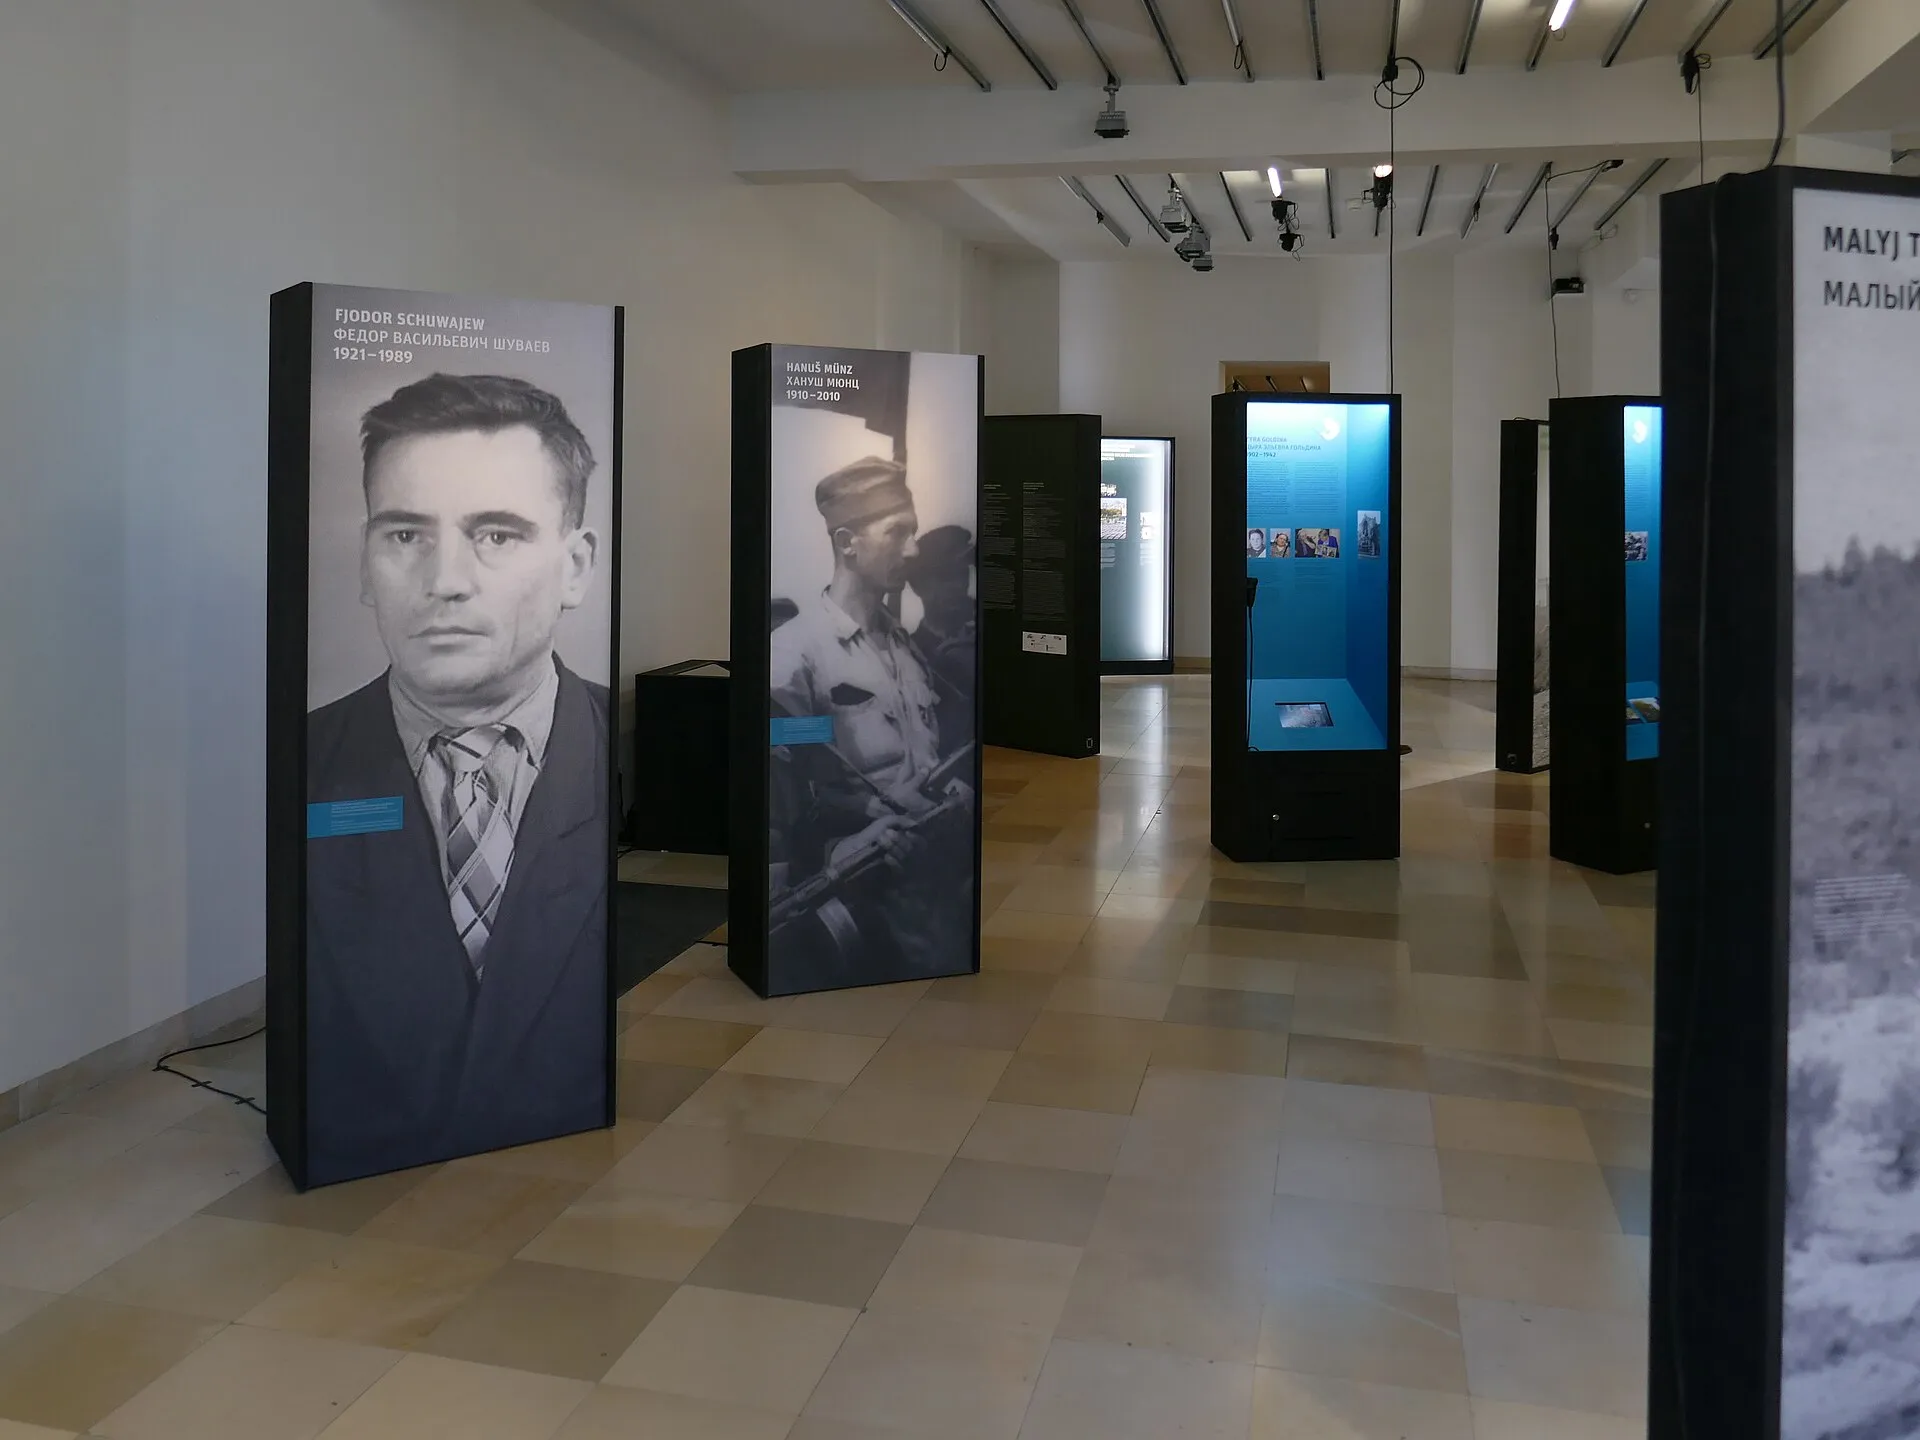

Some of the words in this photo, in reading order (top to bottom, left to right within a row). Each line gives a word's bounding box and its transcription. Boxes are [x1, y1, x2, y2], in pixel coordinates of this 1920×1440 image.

[1824, 226, 1899, 261] MALYJ
[1824, 279, 1920, 311] МАЛЫЙ
[335, 308, 393, 325] FJODOR
[397, 312, 486, 331] SCHUWAJEW
[333, 327, 389, 344] ФЕДОР
[393, 331, 489, 349] ВАСИЛЬЕВИЧ
[493, 337, 550, 353] ШУВАЕВ
[333, 346, 413, 364] 1921–1989
[786, 361, 821, 373] HANUŠ
[824, 362, 853, 375] MÜNZ
[786, 376, 823, 387] ХАНУШ
[827, 378, 860, 390] МЮНЦ
[786, 389, 841, 402] 1910–2010
